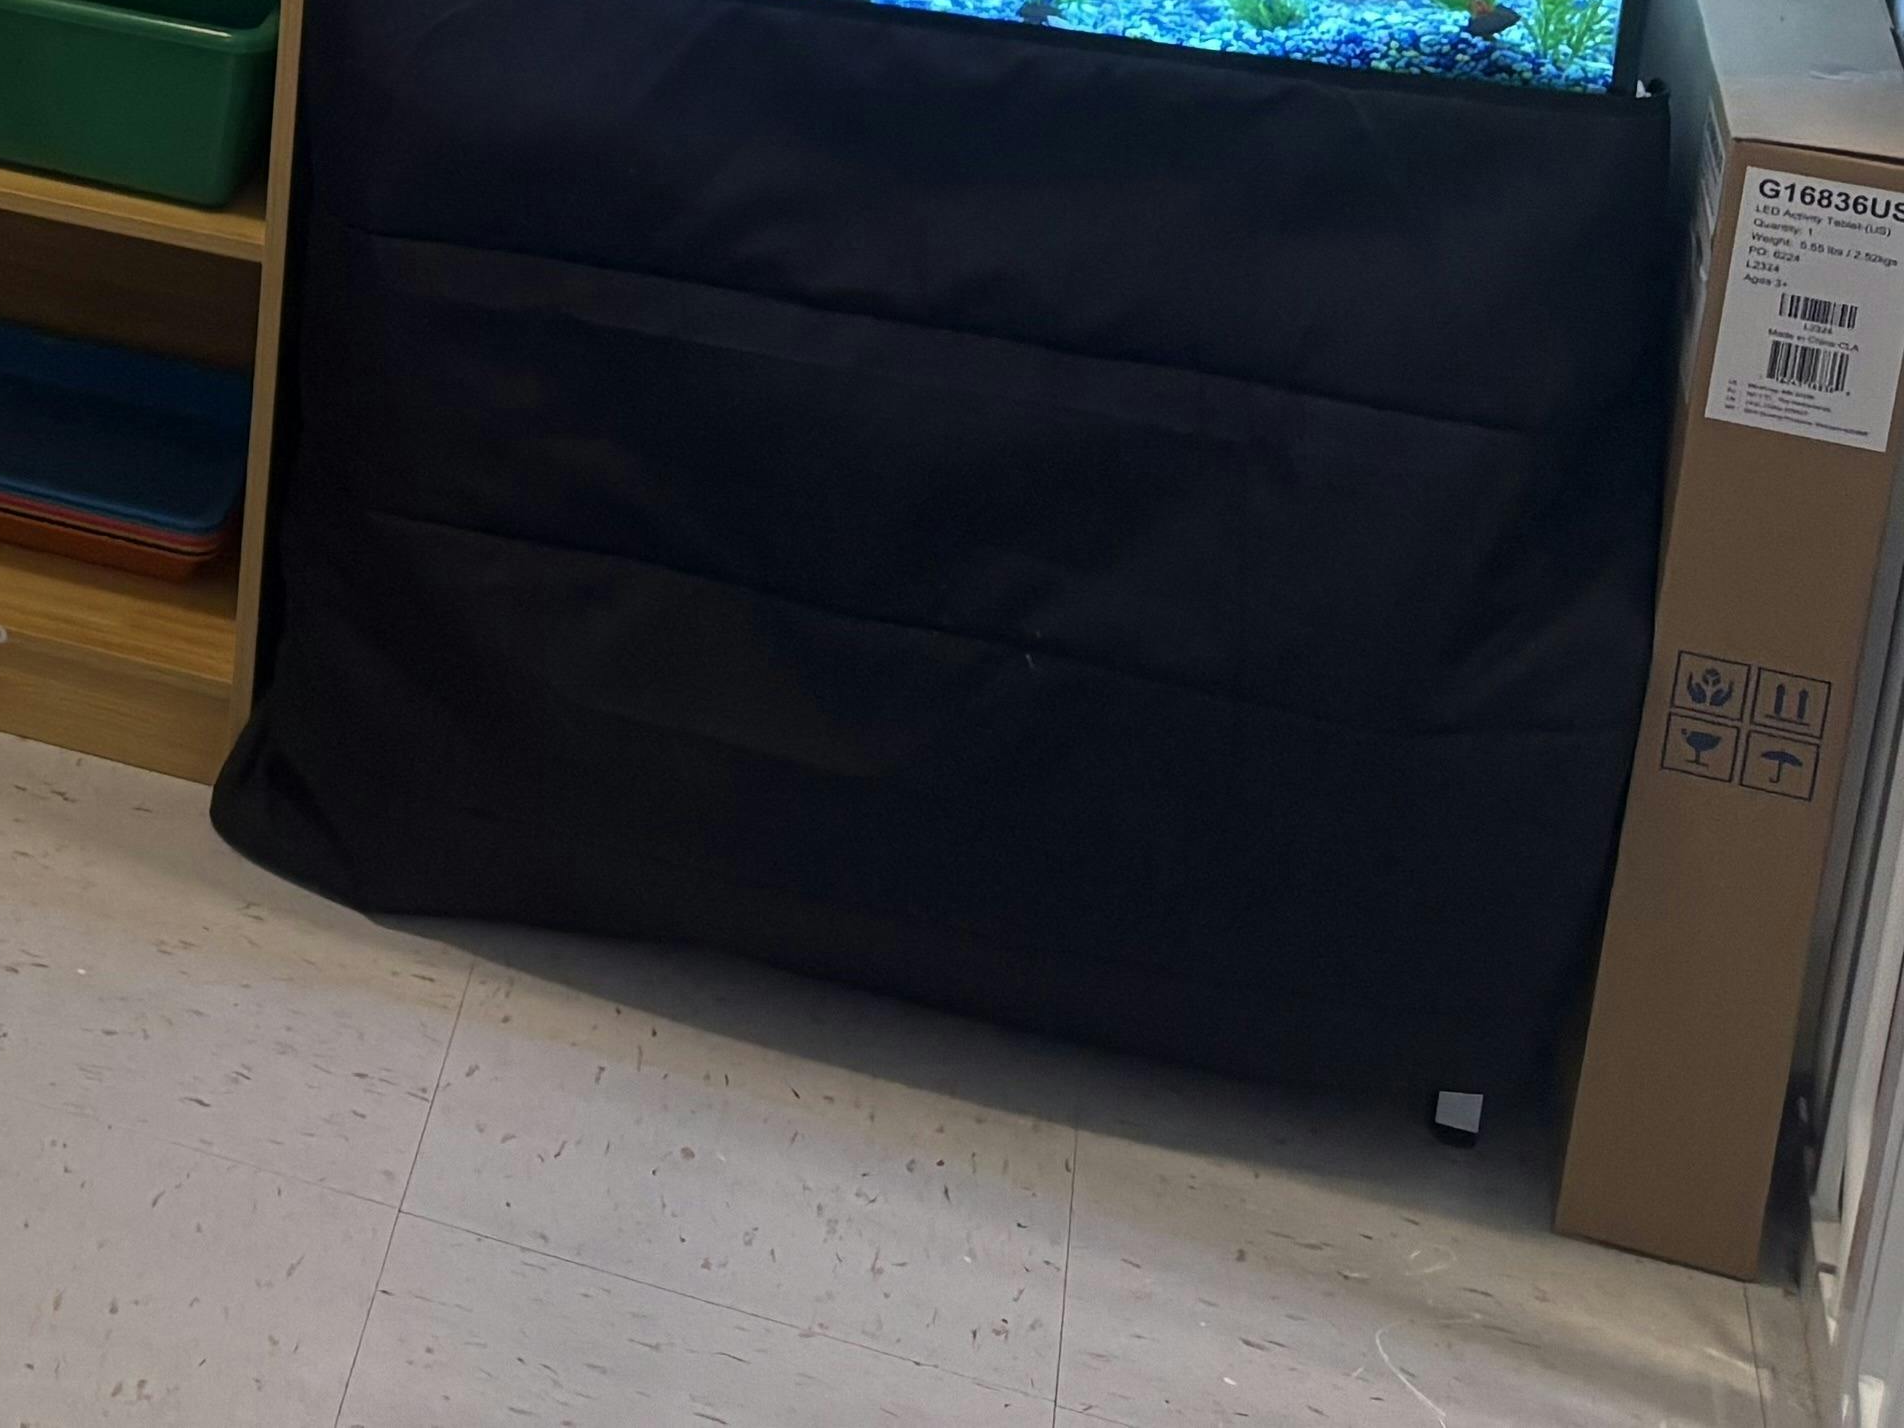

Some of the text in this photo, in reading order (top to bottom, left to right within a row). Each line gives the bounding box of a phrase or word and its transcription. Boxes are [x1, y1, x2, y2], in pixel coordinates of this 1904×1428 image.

[1759, 178, 1904, 223] G16836US
[1755, 204, 1891, 237] LED Activity Tablet (US)
[1808, 228, 1813, 236] 1
[1827, 245, 1843, 256] lbs
[1743, 273, 1771, 287] Ages
